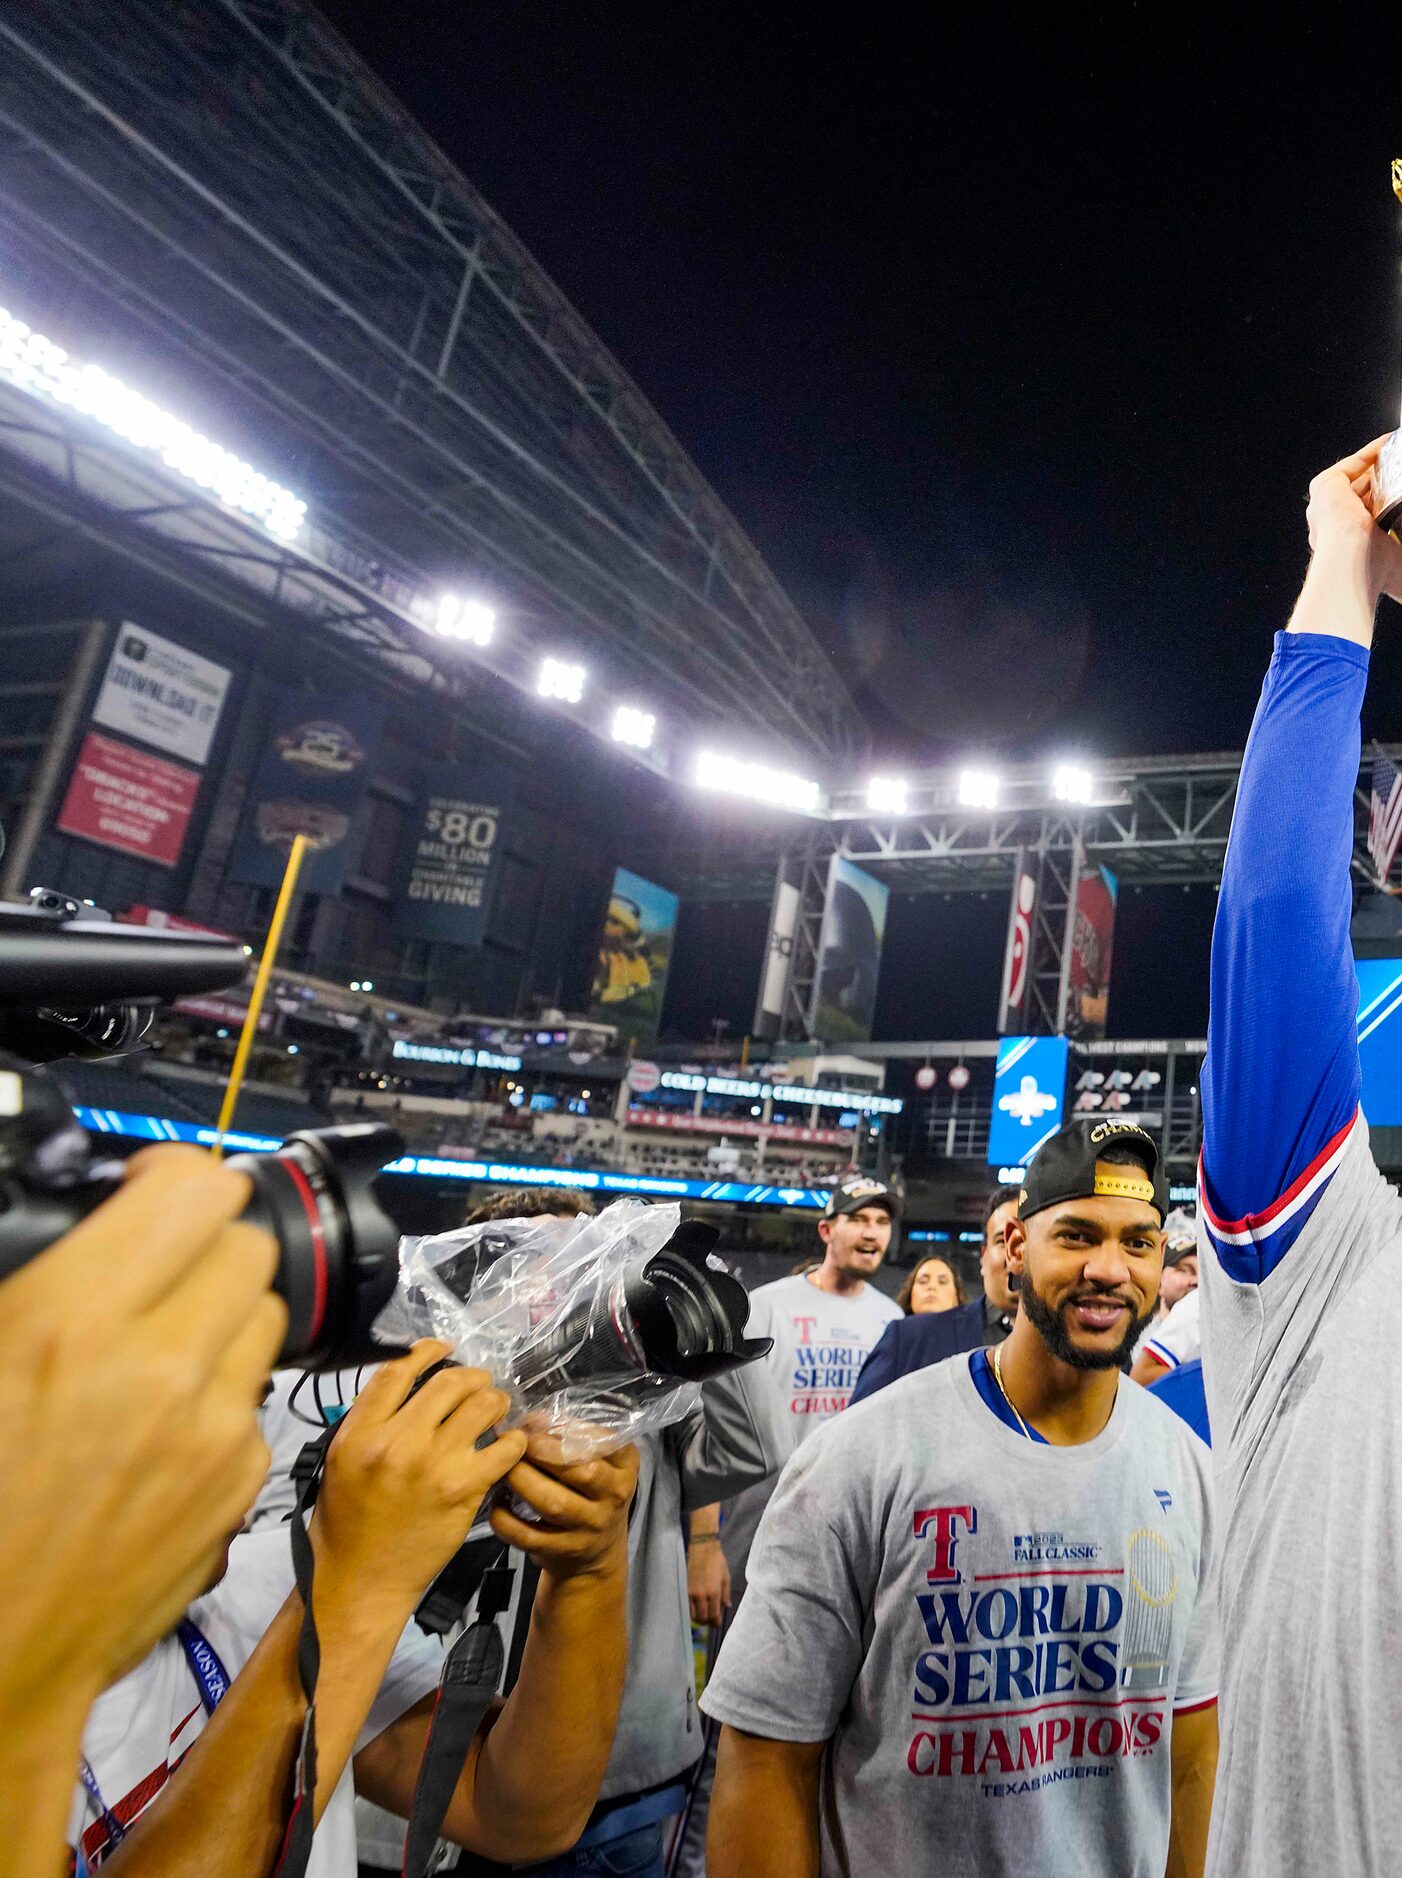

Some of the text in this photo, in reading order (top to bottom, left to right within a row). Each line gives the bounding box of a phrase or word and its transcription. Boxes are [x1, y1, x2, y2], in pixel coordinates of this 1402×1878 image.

[427, 810, 497, 849] $80
[417, 841, 492, 865] MILLION
[409, 880, 482, 907] GIVING
[660, 1071, 707, 1091] COLD
[706, 1077, 761, 1098] BEERS
[793, 1316, 817, 1344] T
[914, 1505, 977, 1586] T
[1014, 1545, 1098, 1561] FALL CLASSIC
[915, 1584, 1123, 1645] WORLD
[914, 1641, 1117, 1706] SERIES
[907, 1713, 1164, 1777] CHAMPIONS
[981, 1766, 1110, 1797] TEXAS RANGERS
